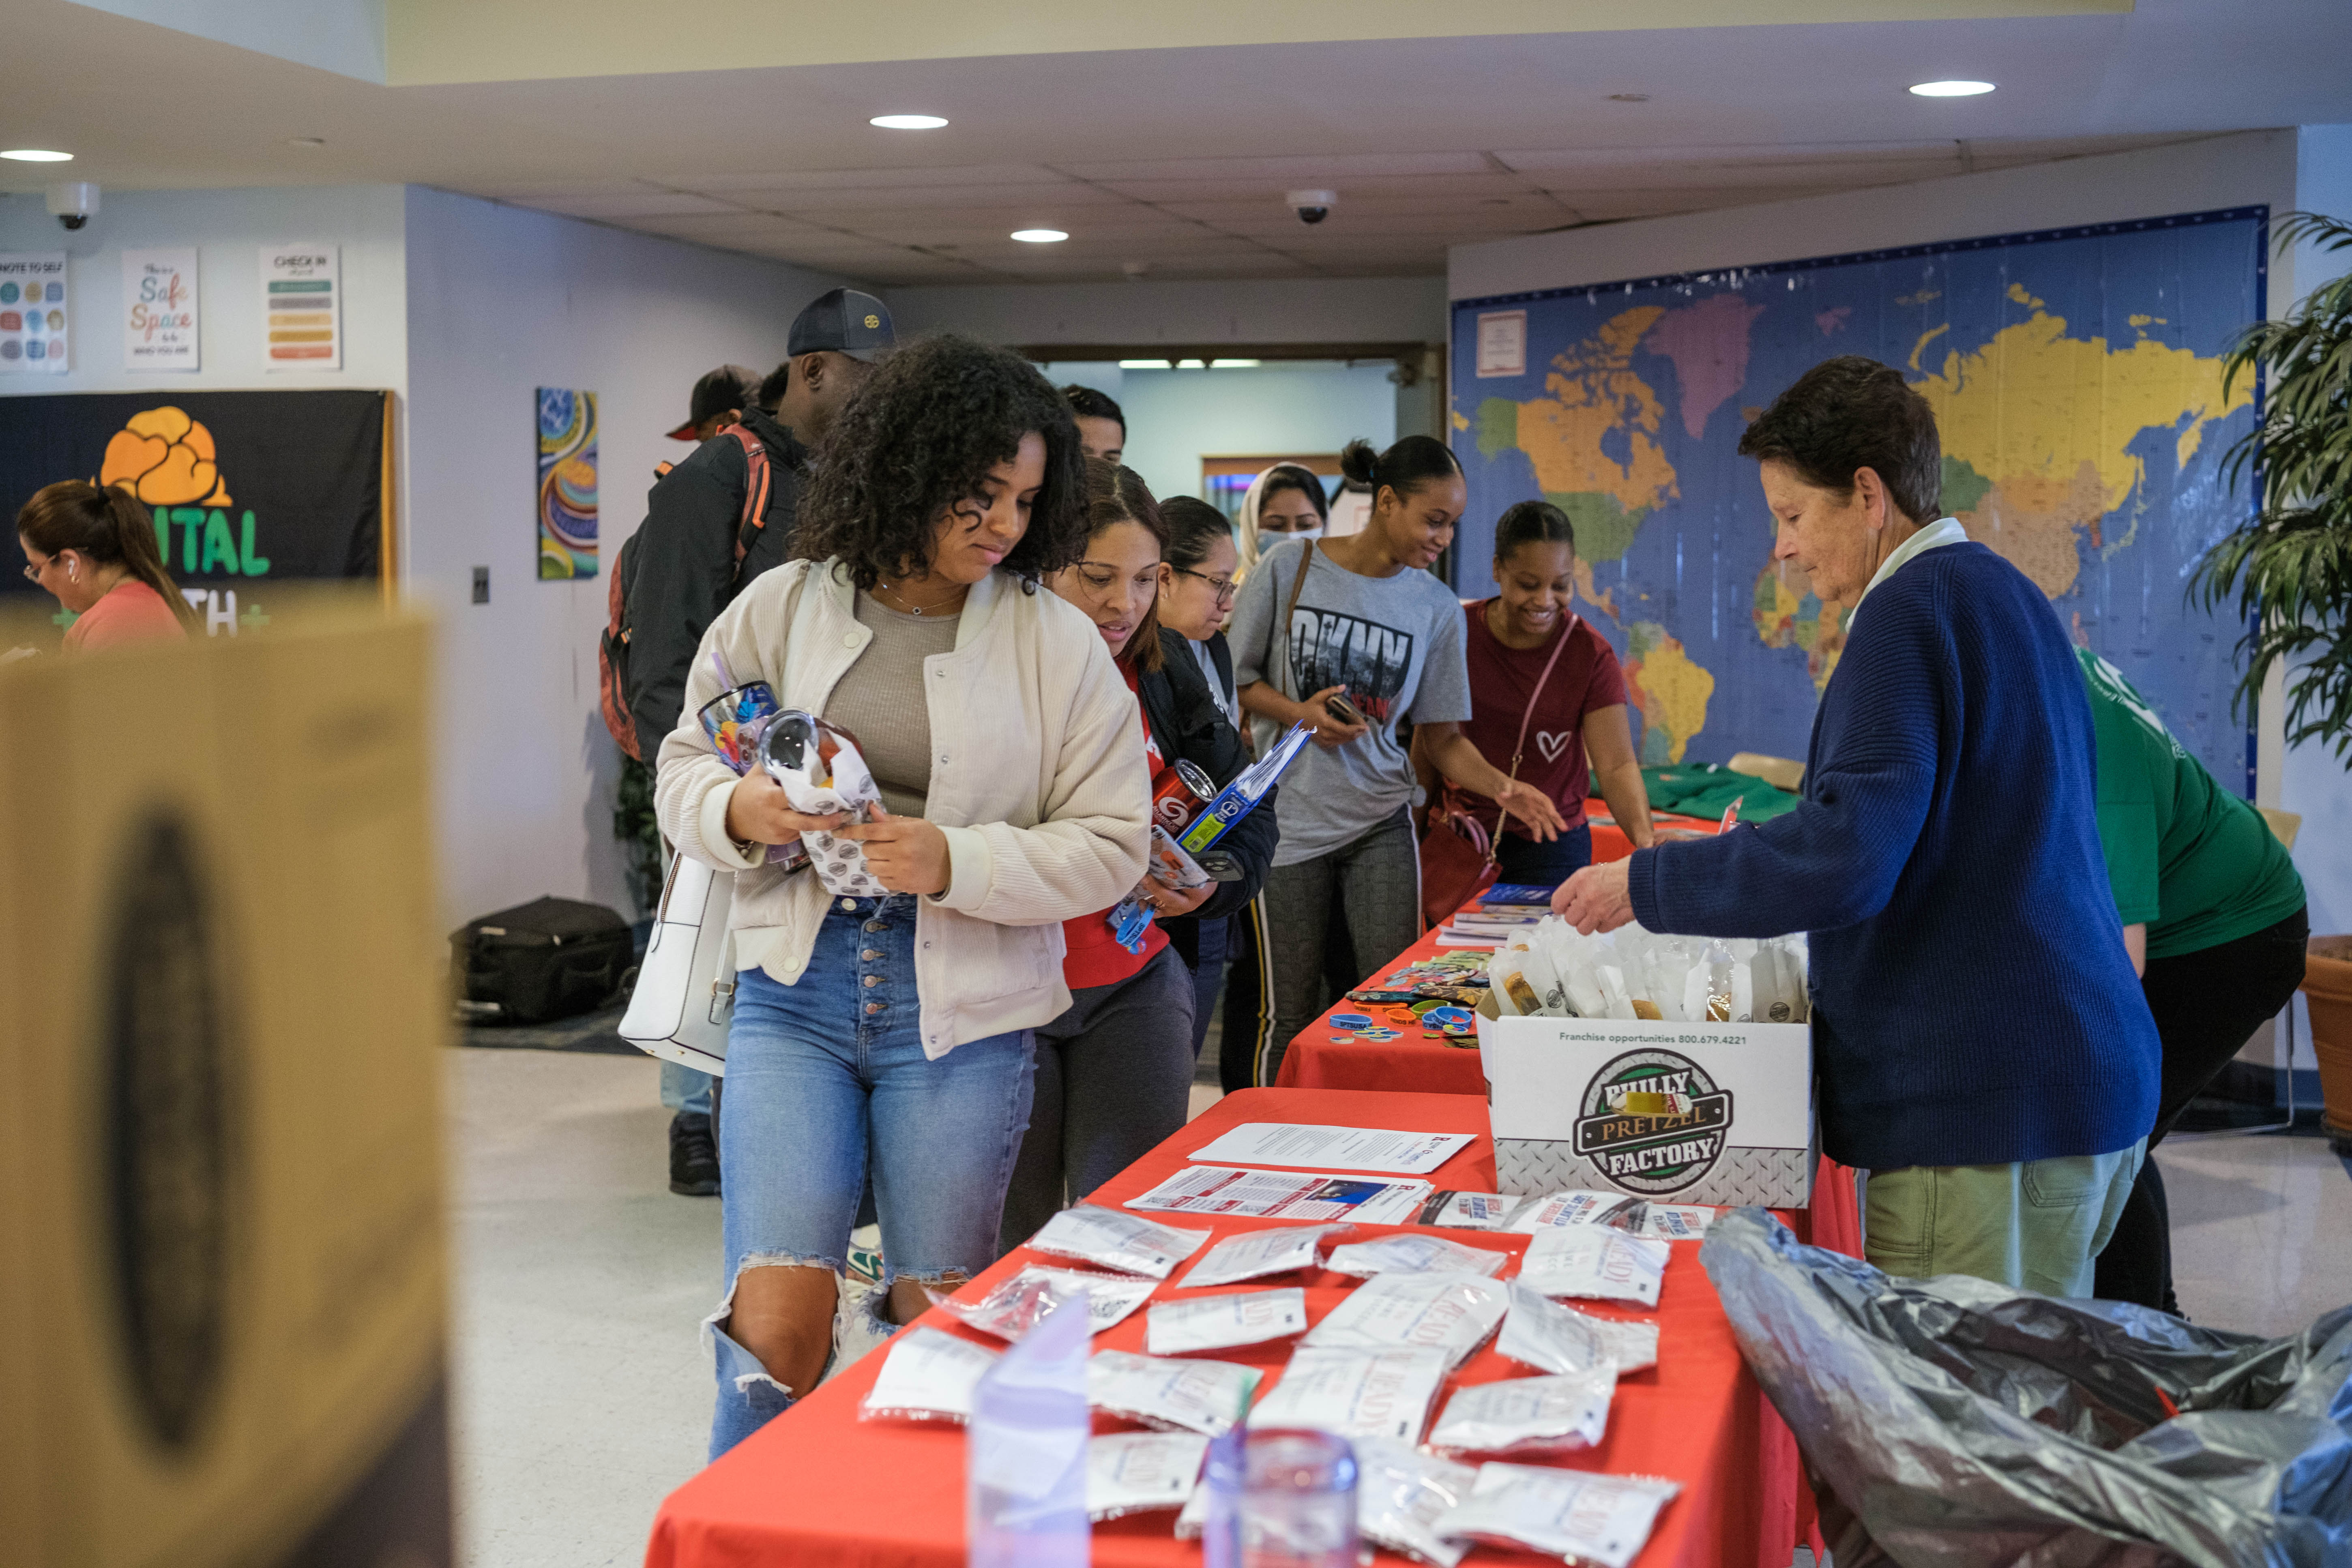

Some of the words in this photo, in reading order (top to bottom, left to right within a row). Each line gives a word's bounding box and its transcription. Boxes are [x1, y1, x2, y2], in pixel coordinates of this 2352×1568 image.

[140, 272, 189, 311] Safe
[130, 303, 193, 344] Space
[1290, 609, 1409, 701] DKNY
[1560, 1032, 1605, 1042] Franchise
[1609, 1034, 1675, 1043] opportunities
[1678, 1035, 1746, 1045] 800.679.4221
[1605, 1071, 1690, 1107] PHILLY
[1602, 1106, 1707, 1141] PRETZEL
[1609, 1137, 1715, 1176] FACTORY
